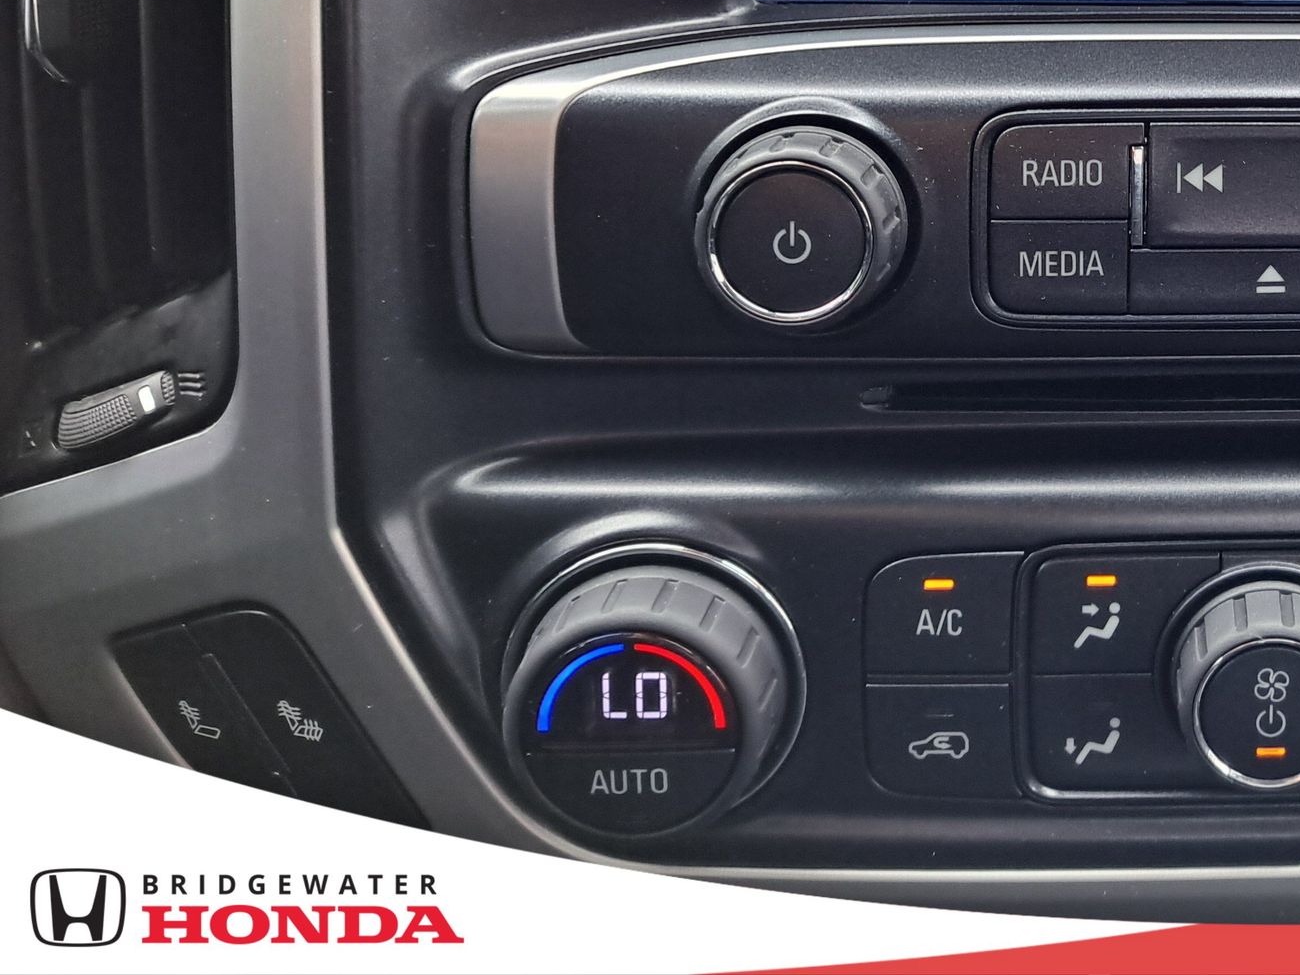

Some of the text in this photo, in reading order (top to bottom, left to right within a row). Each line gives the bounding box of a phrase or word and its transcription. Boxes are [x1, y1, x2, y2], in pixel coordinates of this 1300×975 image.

[1023, 159, 1102, 186] RADIO
[1020, 251, 1104, 276] MEDIA
[917, 609, 962, 635] A/C
[591, 768, 668, 794] AUTO
